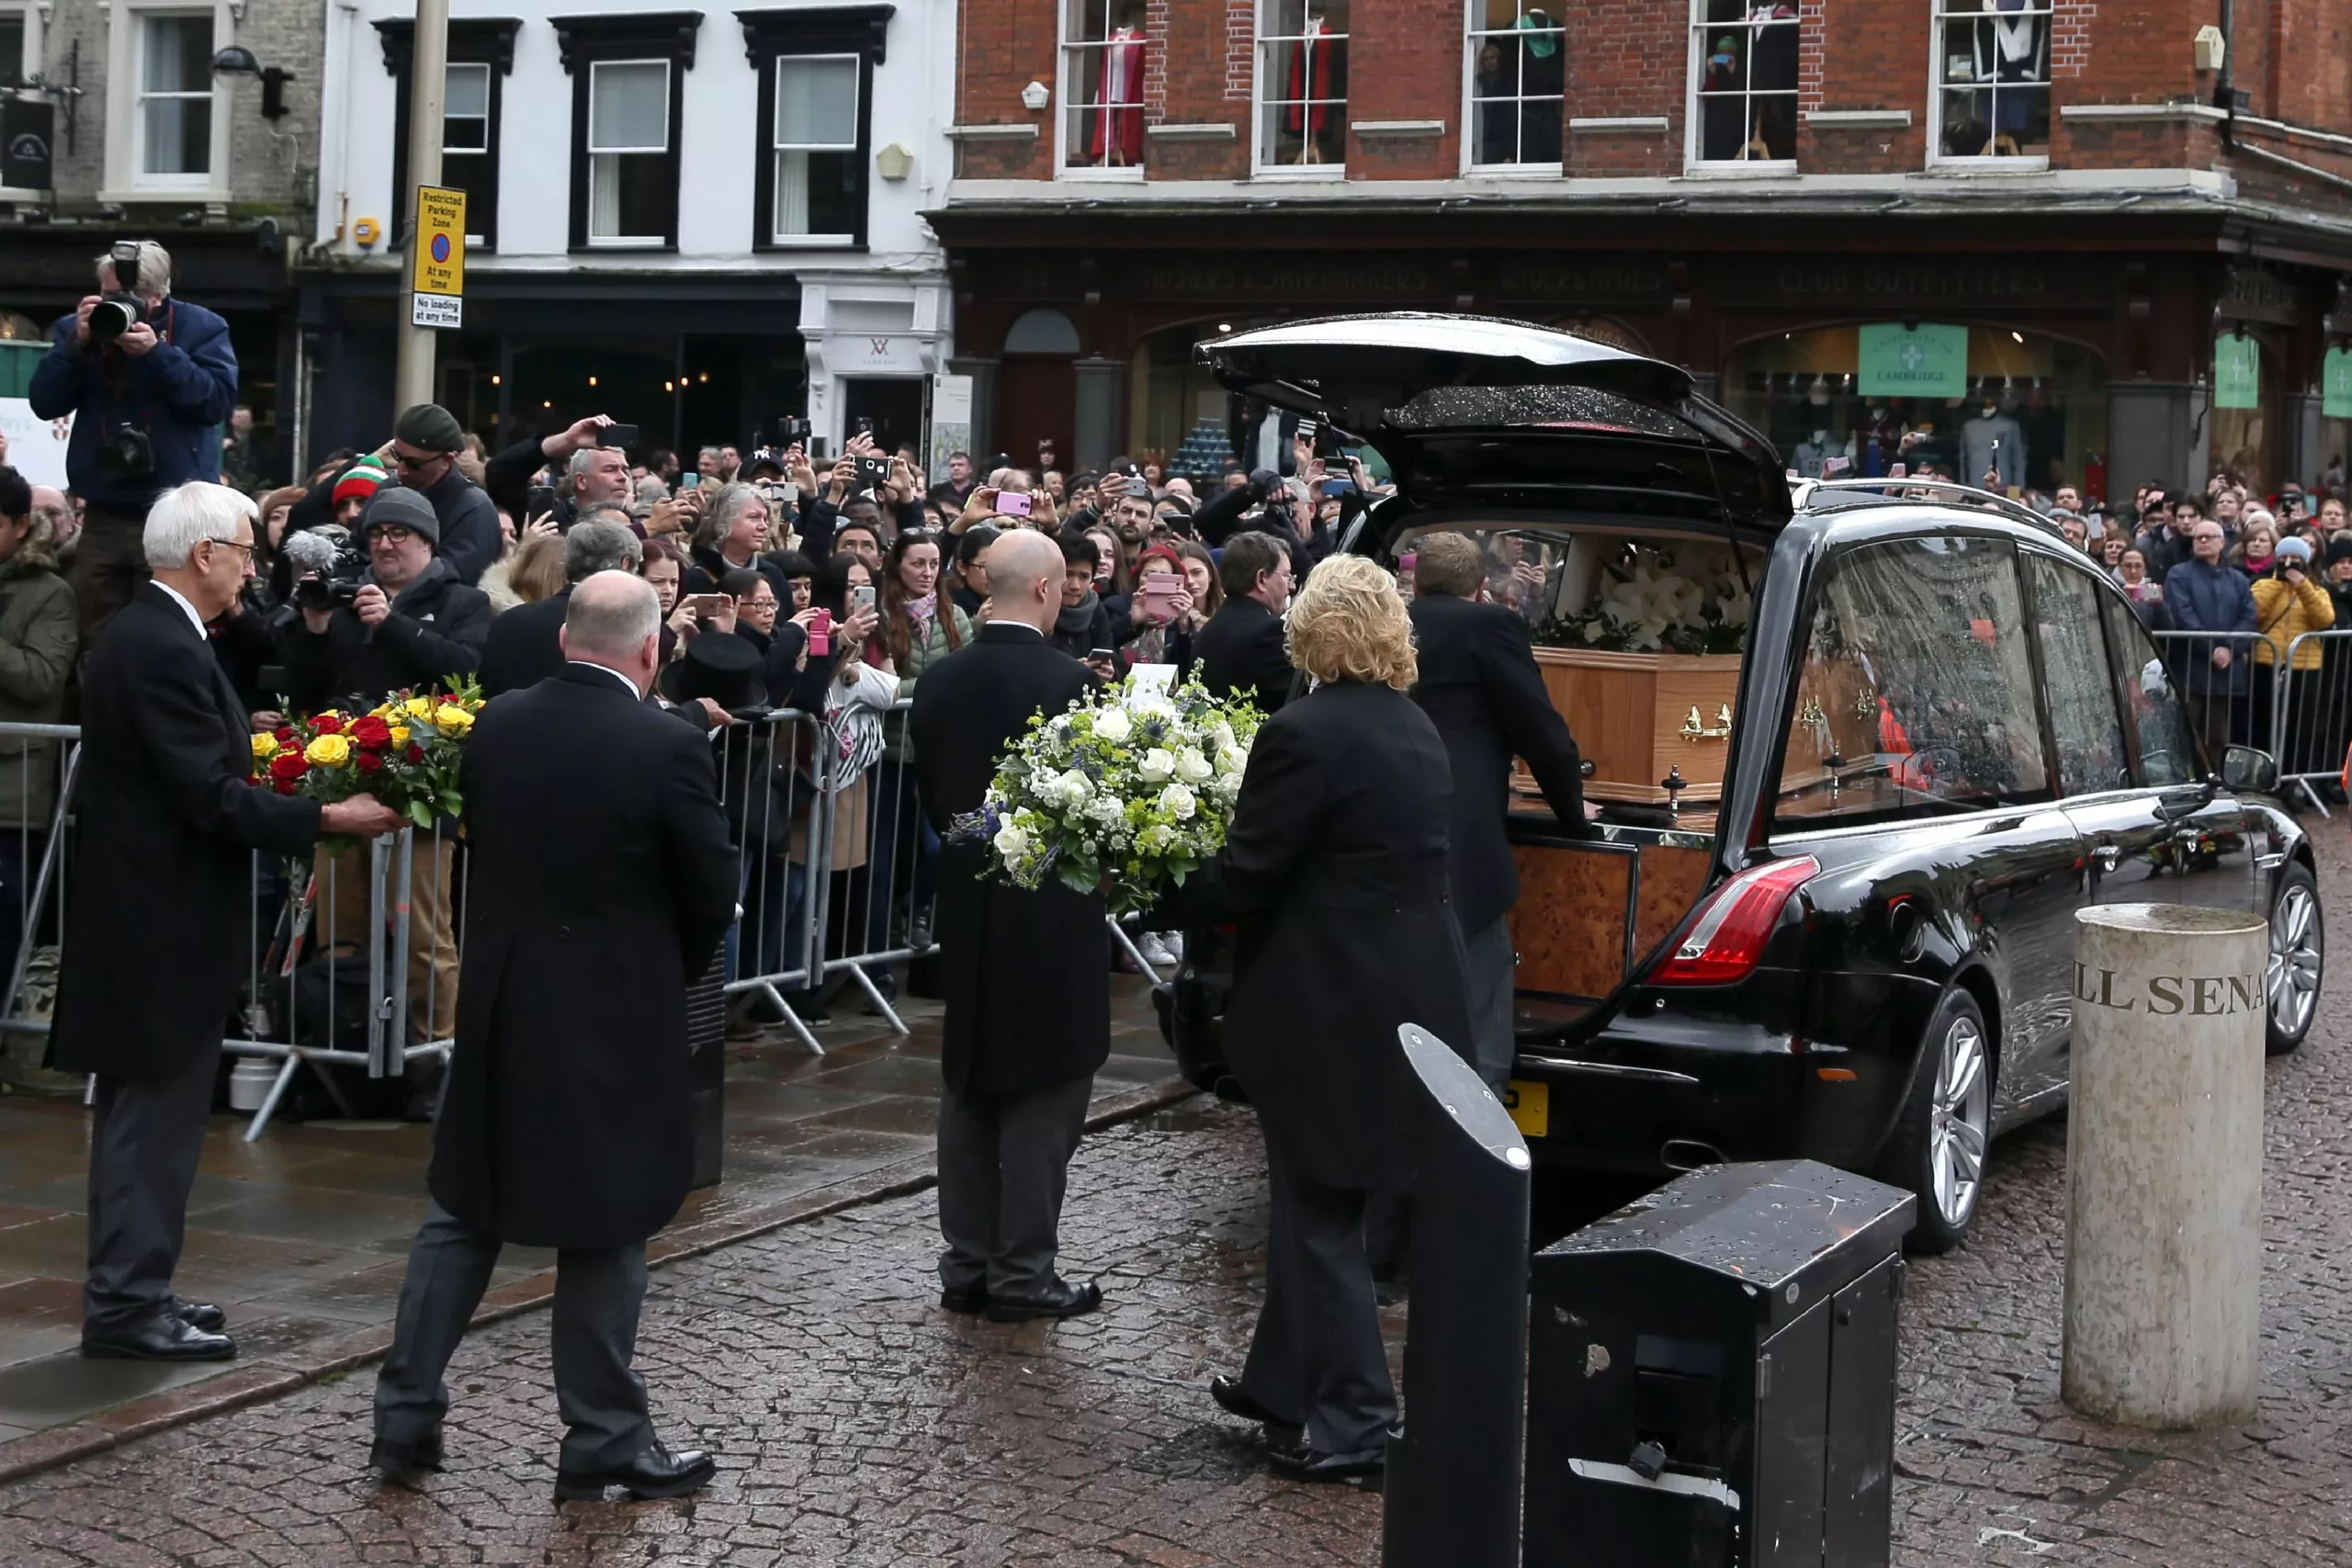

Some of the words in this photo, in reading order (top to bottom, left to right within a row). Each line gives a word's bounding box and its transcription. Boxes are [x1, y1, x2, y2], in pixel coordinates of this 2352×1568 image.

[423, 192, 462, 206] Restricted
[427, 205, 457, 219] Parking
[432, 218, 450, 228] Zone
[426, 265, 436, 276] At
[438, 268, 451, 279] any
[430, 279, 447, 289] time
[1779, 269, 1849, 293] CLUB
[1864, 269, 2044, 294] OUTFITTERS
[417, 298, 428, 309] No
[431, 299, 458, 312] loading
[415, 310, 424, 320] at
[425, 312, 440, 322] any
[442, 312, 458, 322] time
[1877, 371, 1945, 382] CAMBRIDGE
[2147, 968, 2267, 1015] SENA
